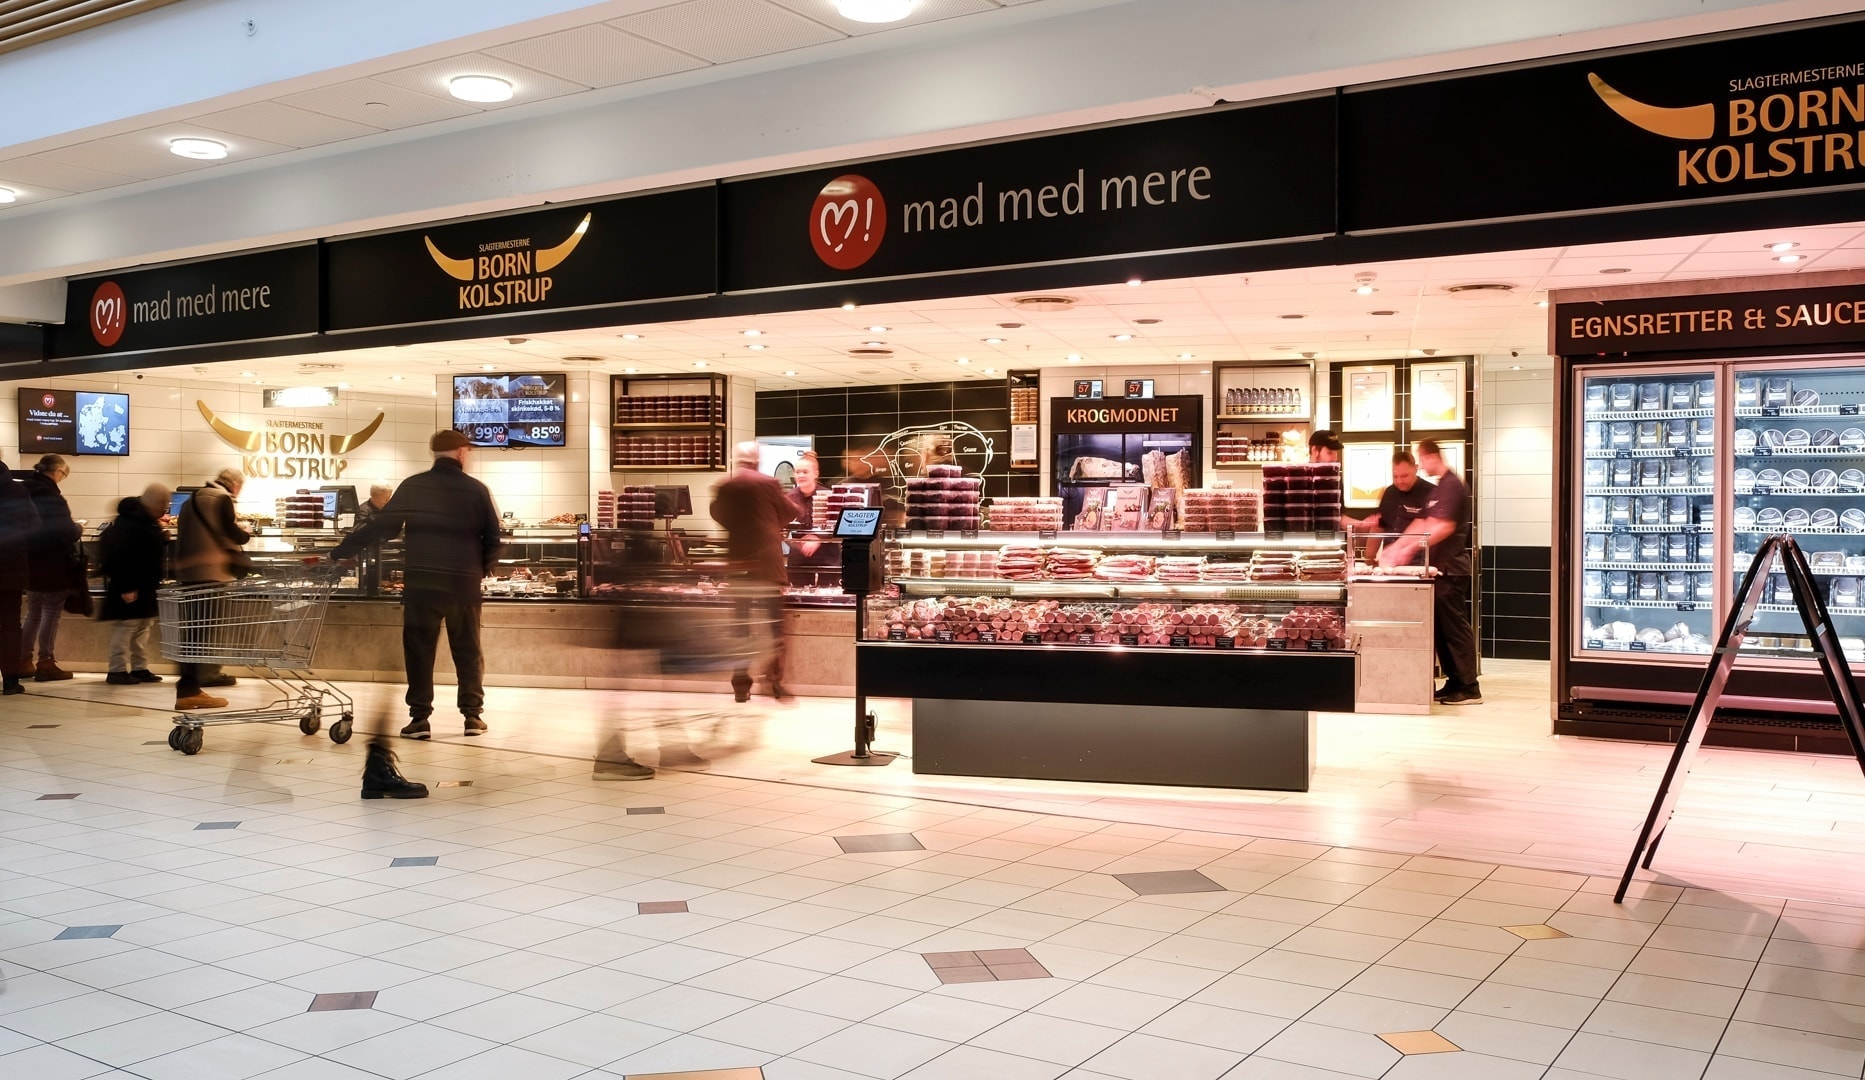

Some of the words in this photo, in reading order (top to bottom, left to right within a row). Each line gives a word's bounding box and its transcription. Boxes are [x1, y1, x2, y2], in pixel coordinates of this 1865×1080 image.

[1729, 63, 1865, 92] SLAGTERMESTERNE
[1729, 84, 1865, 137] BORN
[903, 182, 983, 233] mad
[999, 168, 1085, 222] med
[1101, 165, 1211, 211] mere
[478, 238, 531, 253] SLAGTERMESTERNE
[478, 251, 531, 280] BORN
[133, 290, 171, 323] mad
[177, 284, 216, 318] med
[222, 280, 271, 313] mere
[459, 277, 553, 310] KOLSTRUP
[1571, 309, 1733, 338] EGNSRETTER
[1744, 308, 1766, 330] &
[1078, 384, 1089, 393] 57
[1129, 384, 1140, 393] 57
[1067, 408, 1179, 423] KROGMODNET
[265, 431, 325, 455] BORN
[242, 455, 348, 480] KOLSTRUP
